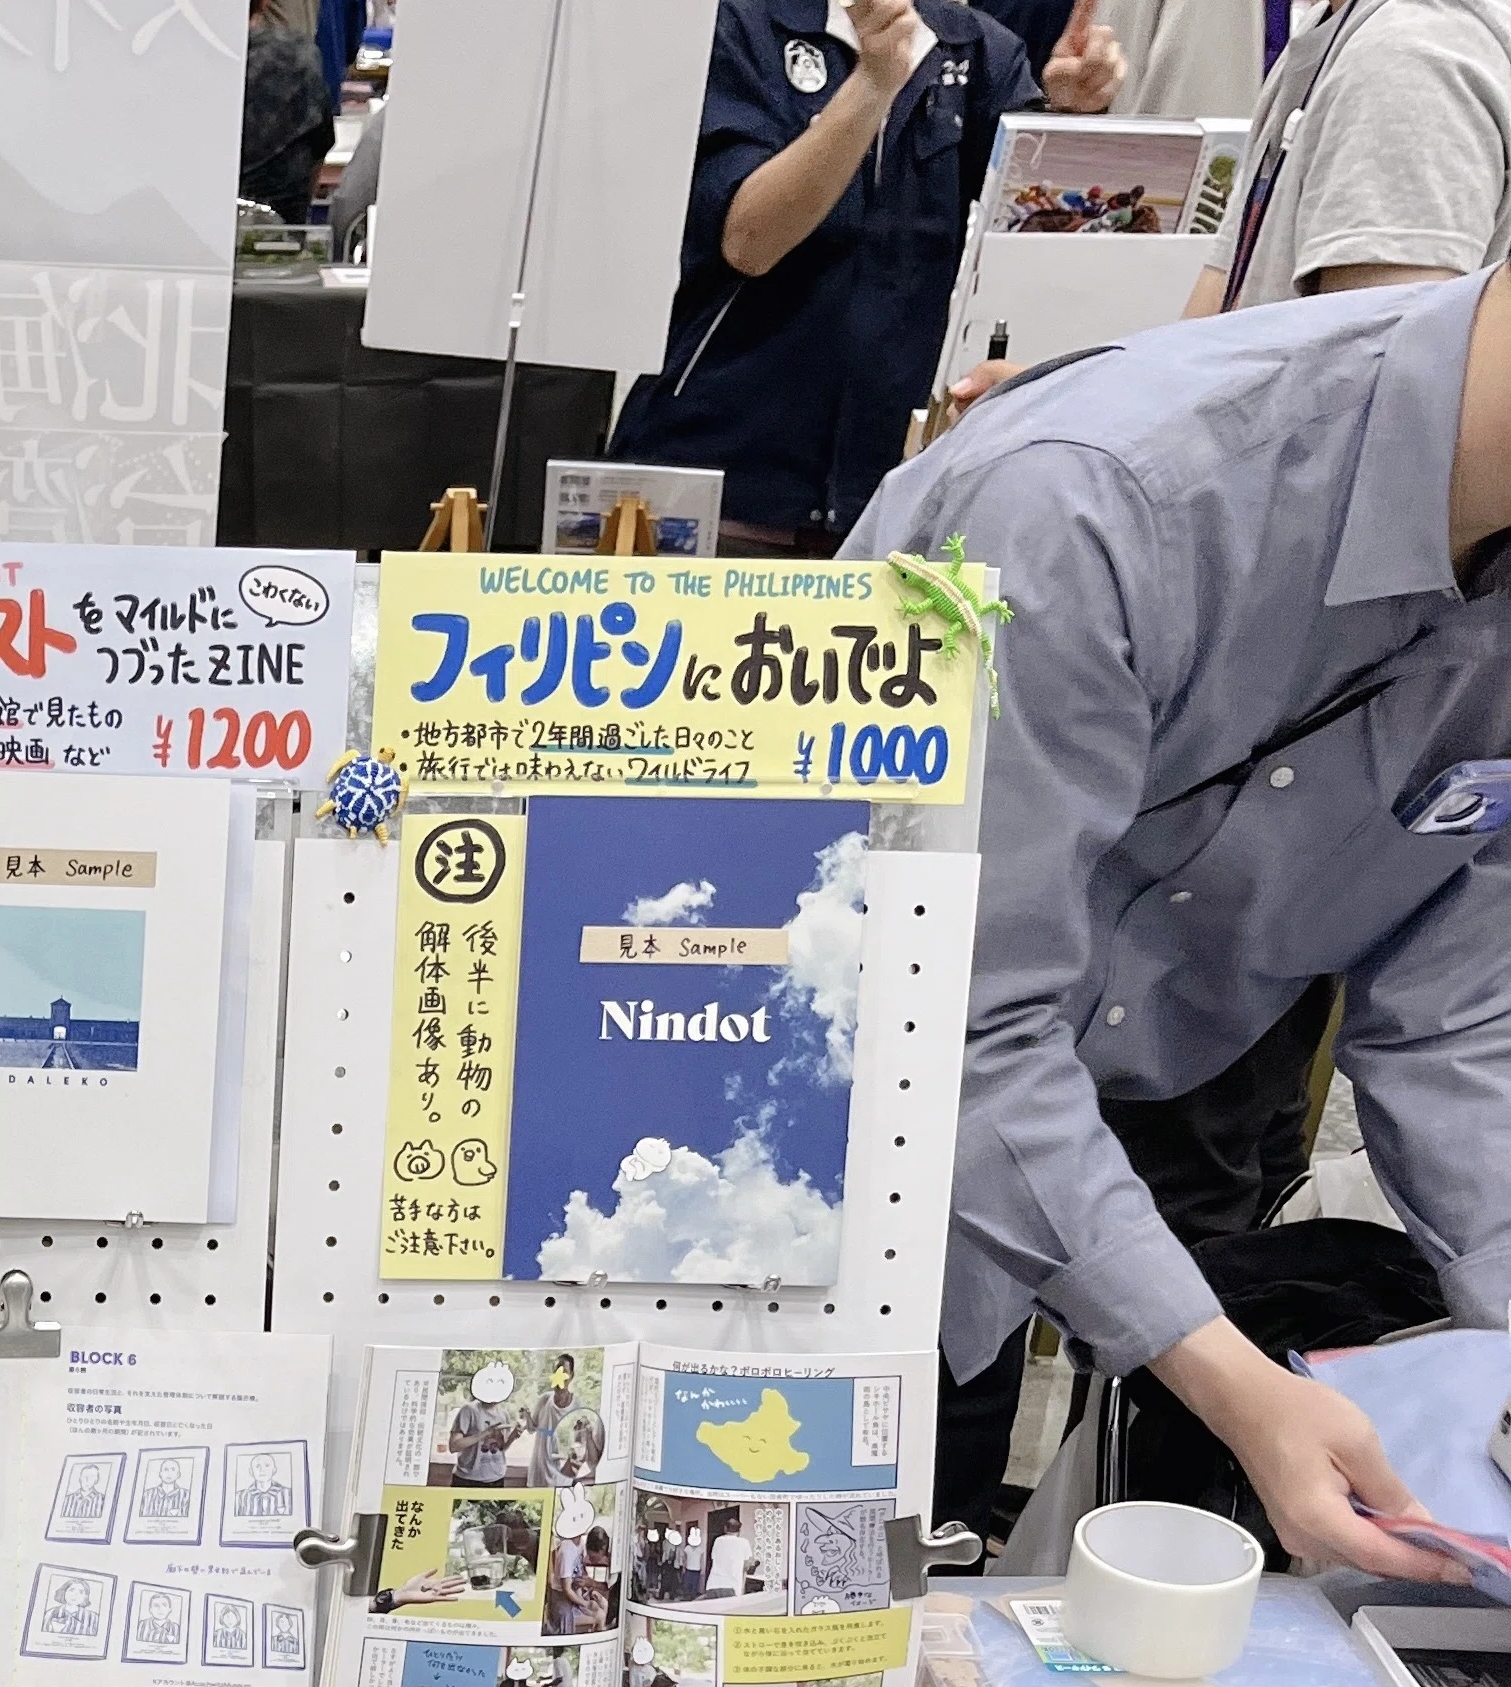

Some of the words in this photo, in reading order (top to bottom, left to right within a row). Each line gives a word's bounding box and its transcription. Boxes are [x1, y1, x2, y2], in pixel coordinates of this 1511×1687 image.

[247, 578, 321, 613] こわくない
[480, 566, 610, 596] WELCOME
[623, 570, 657, 595] TO
[668, 571, 713, 597] THE
[724, 569, 874, 600] PHILIPPINES
[409, 601, 942, 711] フィリピンにおいでよ
[152, 705, 313, 772] ¥1200
[412, 720, 755, 753] 地方都市で2年間過ごした日々のこと
[63, 745, 111, 768] など
[415, 756, 751, 785] 旅行では味わえないワイルドライフ
[793, 722, 950, 787] ¥1000
[5, 854, 47, 879] 見本
[65, 858, 134, 880] Sample
[618, 934, 662, 959] 見本
[679, 936, 749, 959] Sample
[413, 922, 453, 1124] 解体画像あり。
[456, 920, 499, 1118] 後半に動物の
[597, 1000, 773, 1044] Nindot
[7, 1073, 110, 1088] DALEKO
[389, 1195, 483, 1223] 苦手な方は
[385, 1229, 496, 1260] ご注意下さい。
[70, 1350, 124, 1366] BLOCK
[127, 1353, 138, 1366] 6
[675, 1386, 716, 1404] なんか
[390, 1499, 409, 1550] 出てきた
[407, 1499, 425, 1539] なんか
